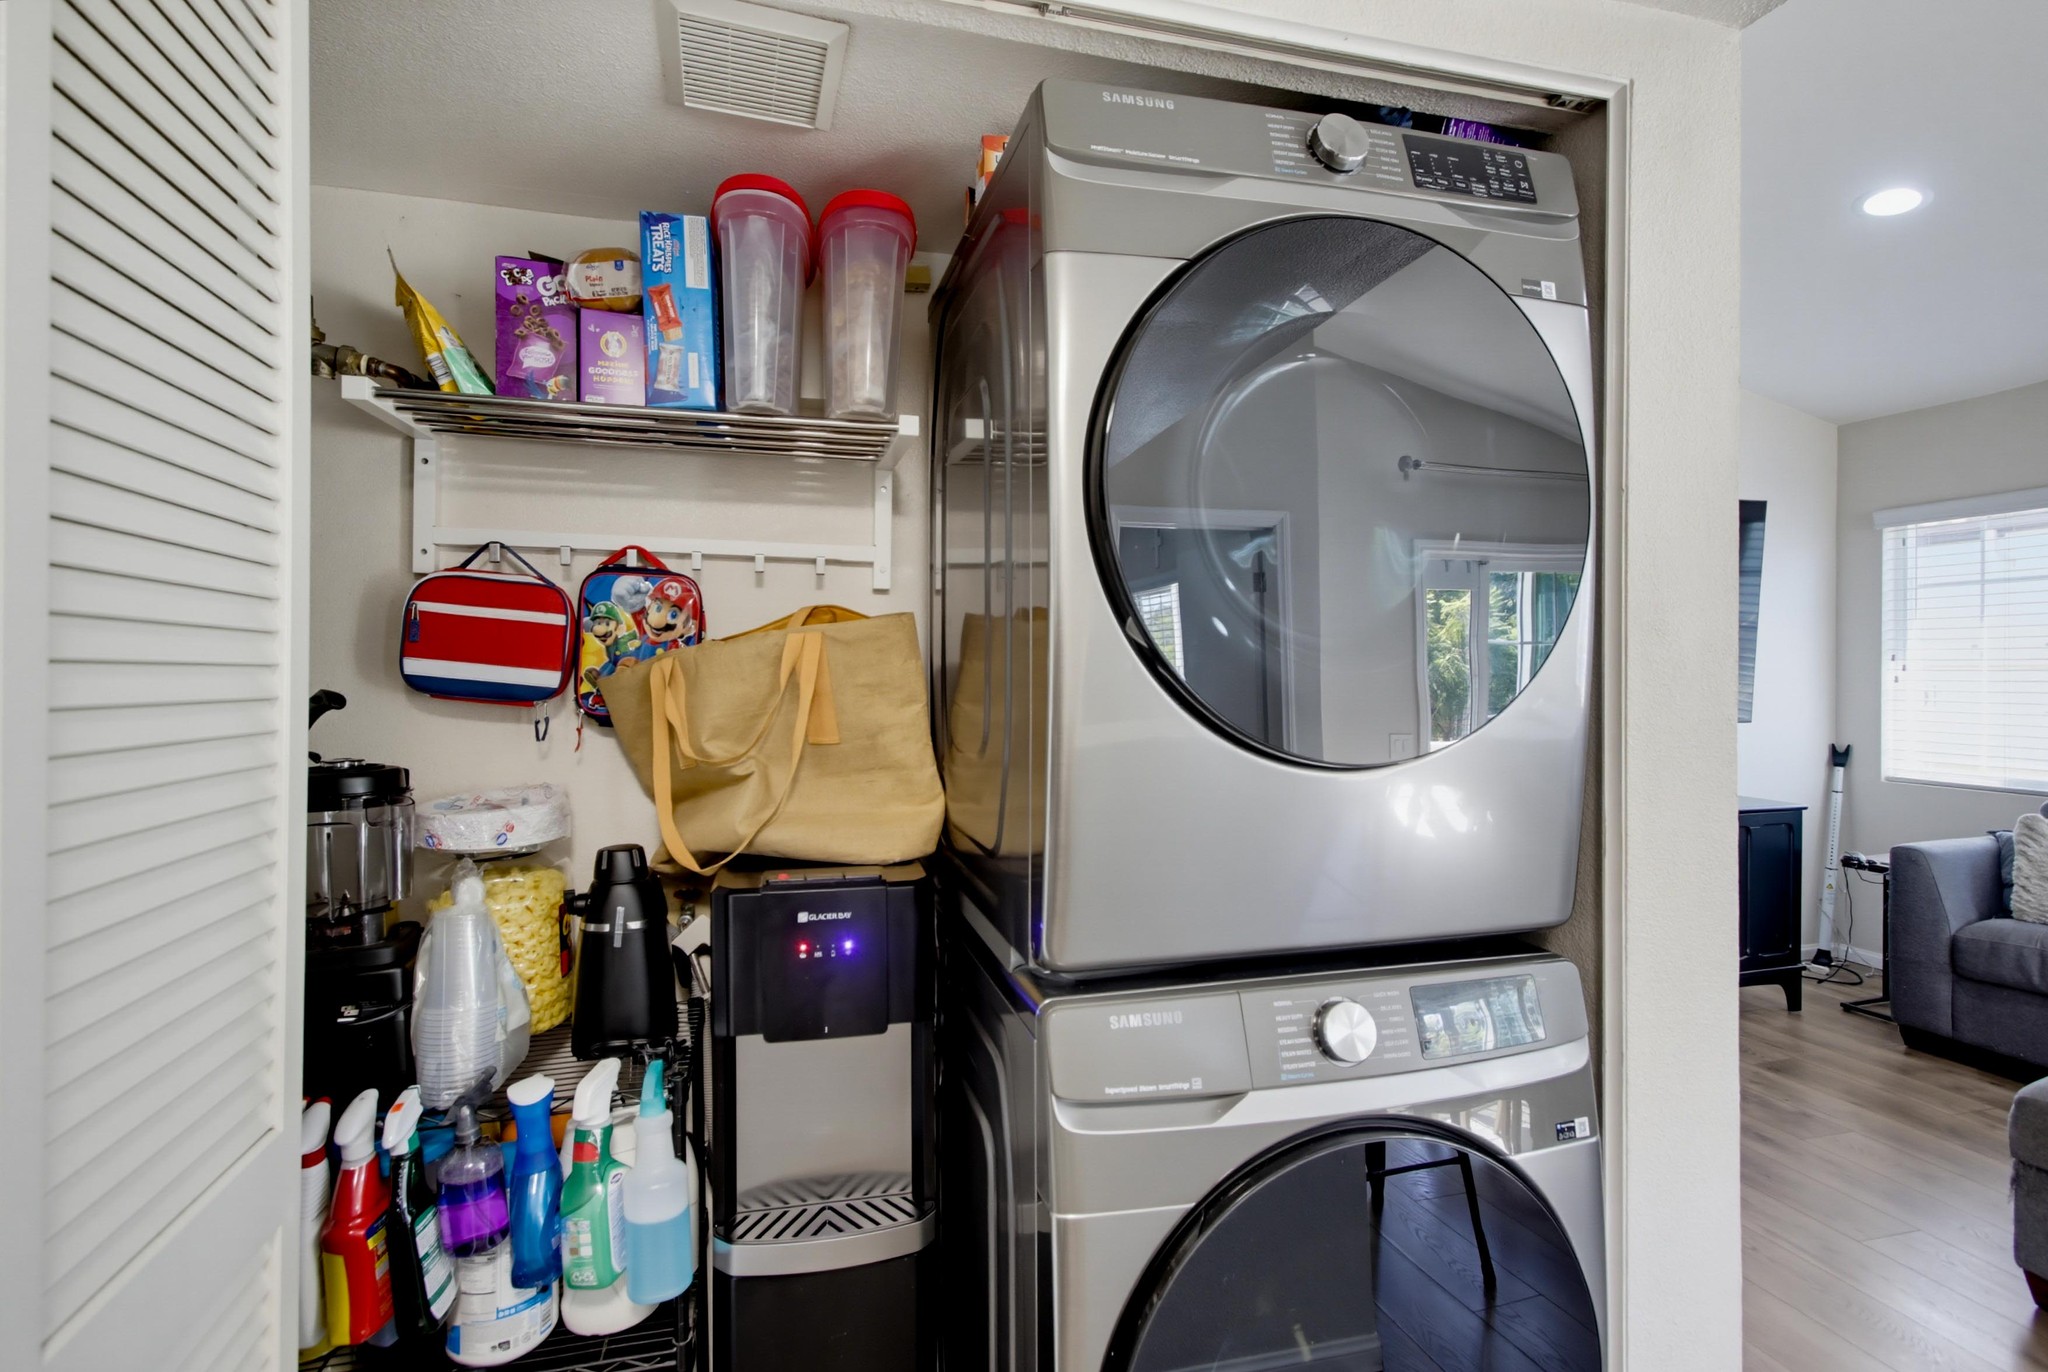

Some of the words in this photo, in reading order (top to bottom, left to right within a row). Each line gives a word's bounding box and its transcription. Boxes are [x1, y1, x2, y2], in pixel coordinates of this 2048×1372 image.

[1102, 91, 1175, 110] SAMSUNG
[661, 222, 671, 239] RICE
[650, 223, 665, 272] TREATS
[585, 275, 604, 283] Plain
[808, 913, 837, 921] GLACIER
[838, 911, 852, 919] BAY
[1109, 1010, 1183, 1029] SAMSUNG
